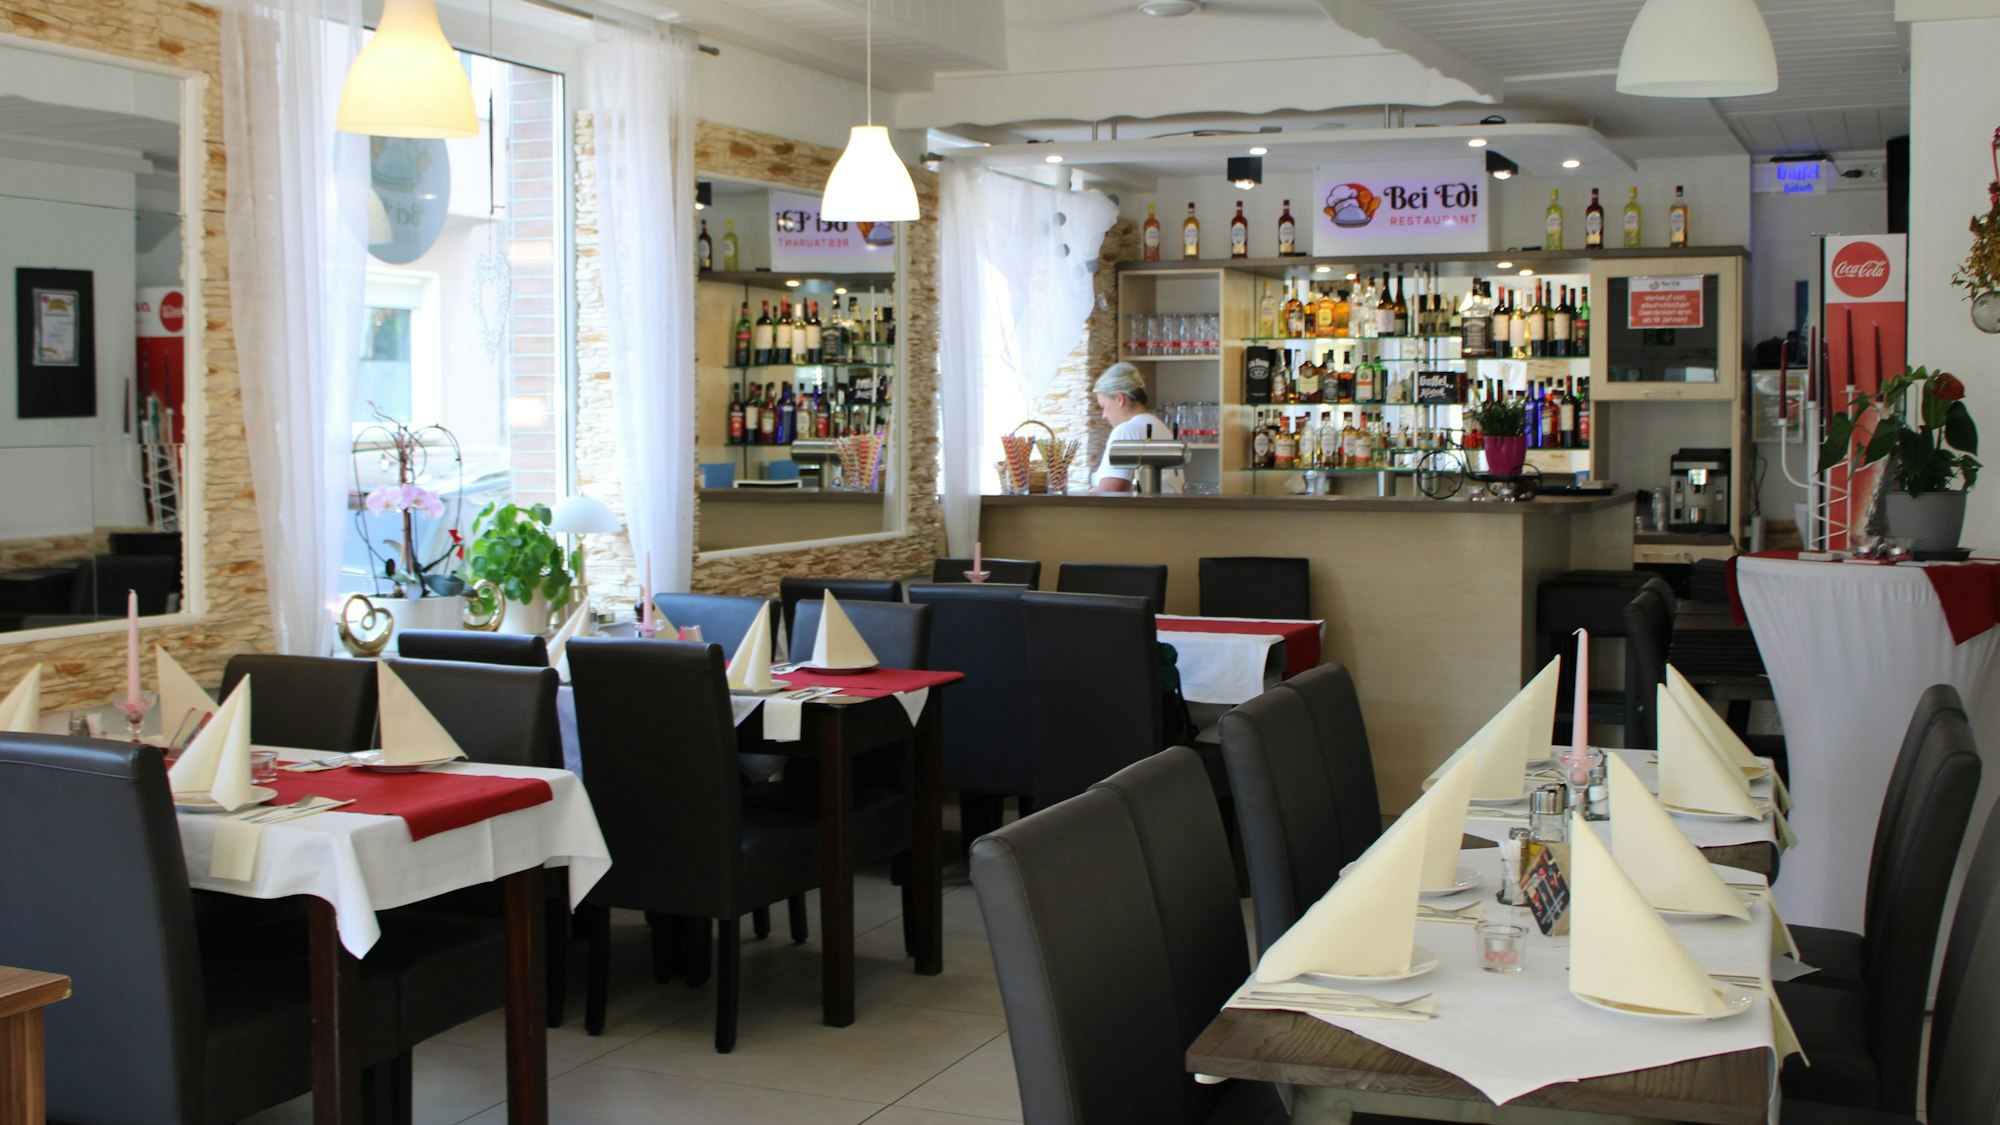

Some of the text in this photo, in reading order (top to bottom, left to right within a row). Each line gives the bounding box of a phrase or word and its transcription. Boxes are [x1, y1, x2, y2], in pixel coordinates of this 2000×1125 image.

[1383, 182, 1478, 210] Bei Edi
[1390, 214, 1477, 225] RESTAURANT
[1834, 260, 1888, 278] Coca-Cola
